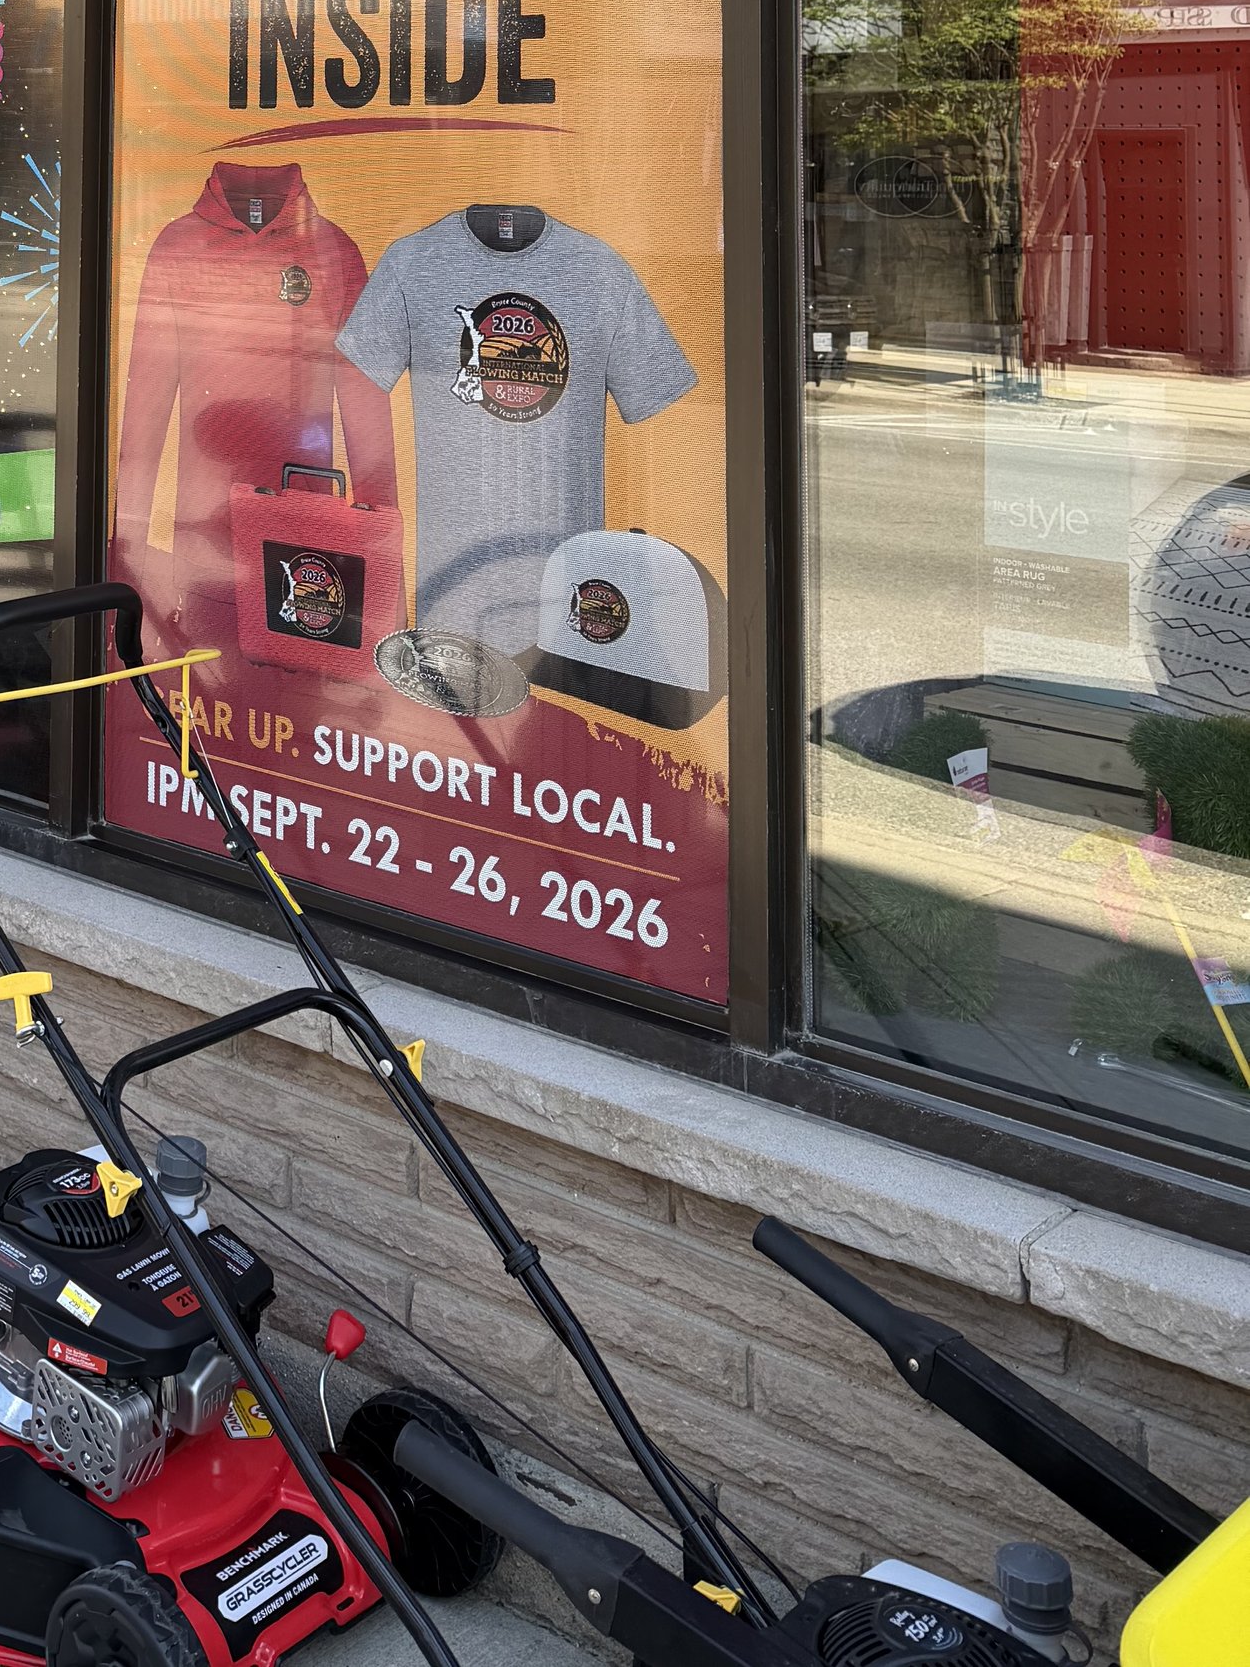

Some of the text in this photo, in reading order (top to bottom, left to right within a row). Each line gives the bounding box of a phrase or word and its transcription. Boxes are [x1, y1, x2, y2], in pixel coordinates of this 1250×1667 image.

[510, 297, 535, 311] County
[492, 314, 536, 335] 2026
[482, 360, 546, 372] INTERNATIONAL
[521, 370, 564, 384] MATCH
[495, 385, 536, 399] & RURAL
[507, 394, 531, 403] EXPO
[1009, 497, 1090, 539] style
[301, 568, 327, 584] 2026
[993, 565, 1046, 582] AREA RUG
[1029, 560, 1071, 575] WASHABLE
[433, 646, 472, 662] 2026
[248, 707, 300, 759] UP.
[314, 724, 497, 808] SUPPORT
[512, 771, 677, 854] LOCAL.
[230, 785, 331, 854] SEPT.
[347, 818, 400, 875] 22
[415, 860, 434, 874] -
[449, 845, 520, 916] 26,
[540, 871, 670, 948] 2026
[116, 1268, 133, 1281] GAS
[131, 1257, 152, 1274] LAWN
[141, 1263, 177, 1285] TONDEUSE
[159, 1271, 182, 1289] GAZON
[216, 1531, 289, 1581] BENCHMARK
[226, 1542, 319, 1611] GRASSCYCLER
[252, 1573, 319, 1625] DESIGNED IN CANADA
[905, 1619, 930, 1642] 150
